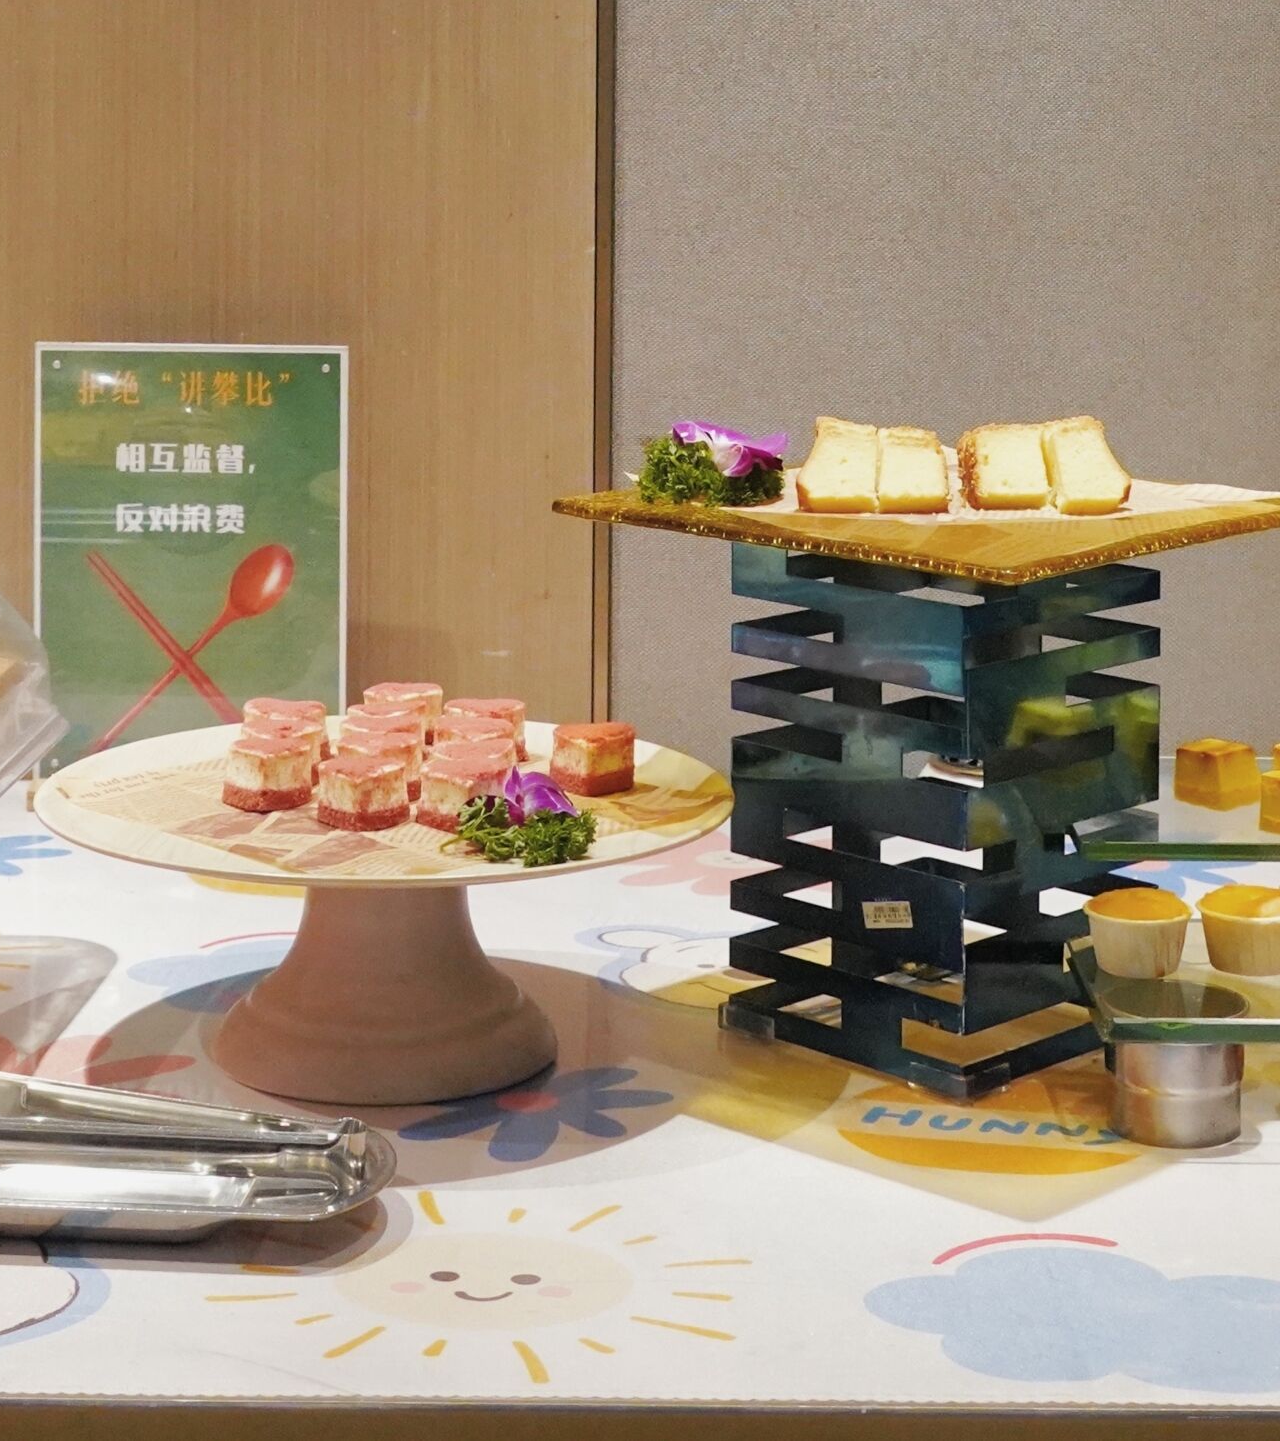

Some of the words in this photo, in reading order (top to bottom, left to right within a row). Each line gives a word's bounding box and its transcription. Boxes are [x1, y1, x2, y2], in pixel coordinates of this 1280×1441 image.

[115, 442, 257, 475] 相互监督，
[115, 502, 247, 535] 反对浪费
